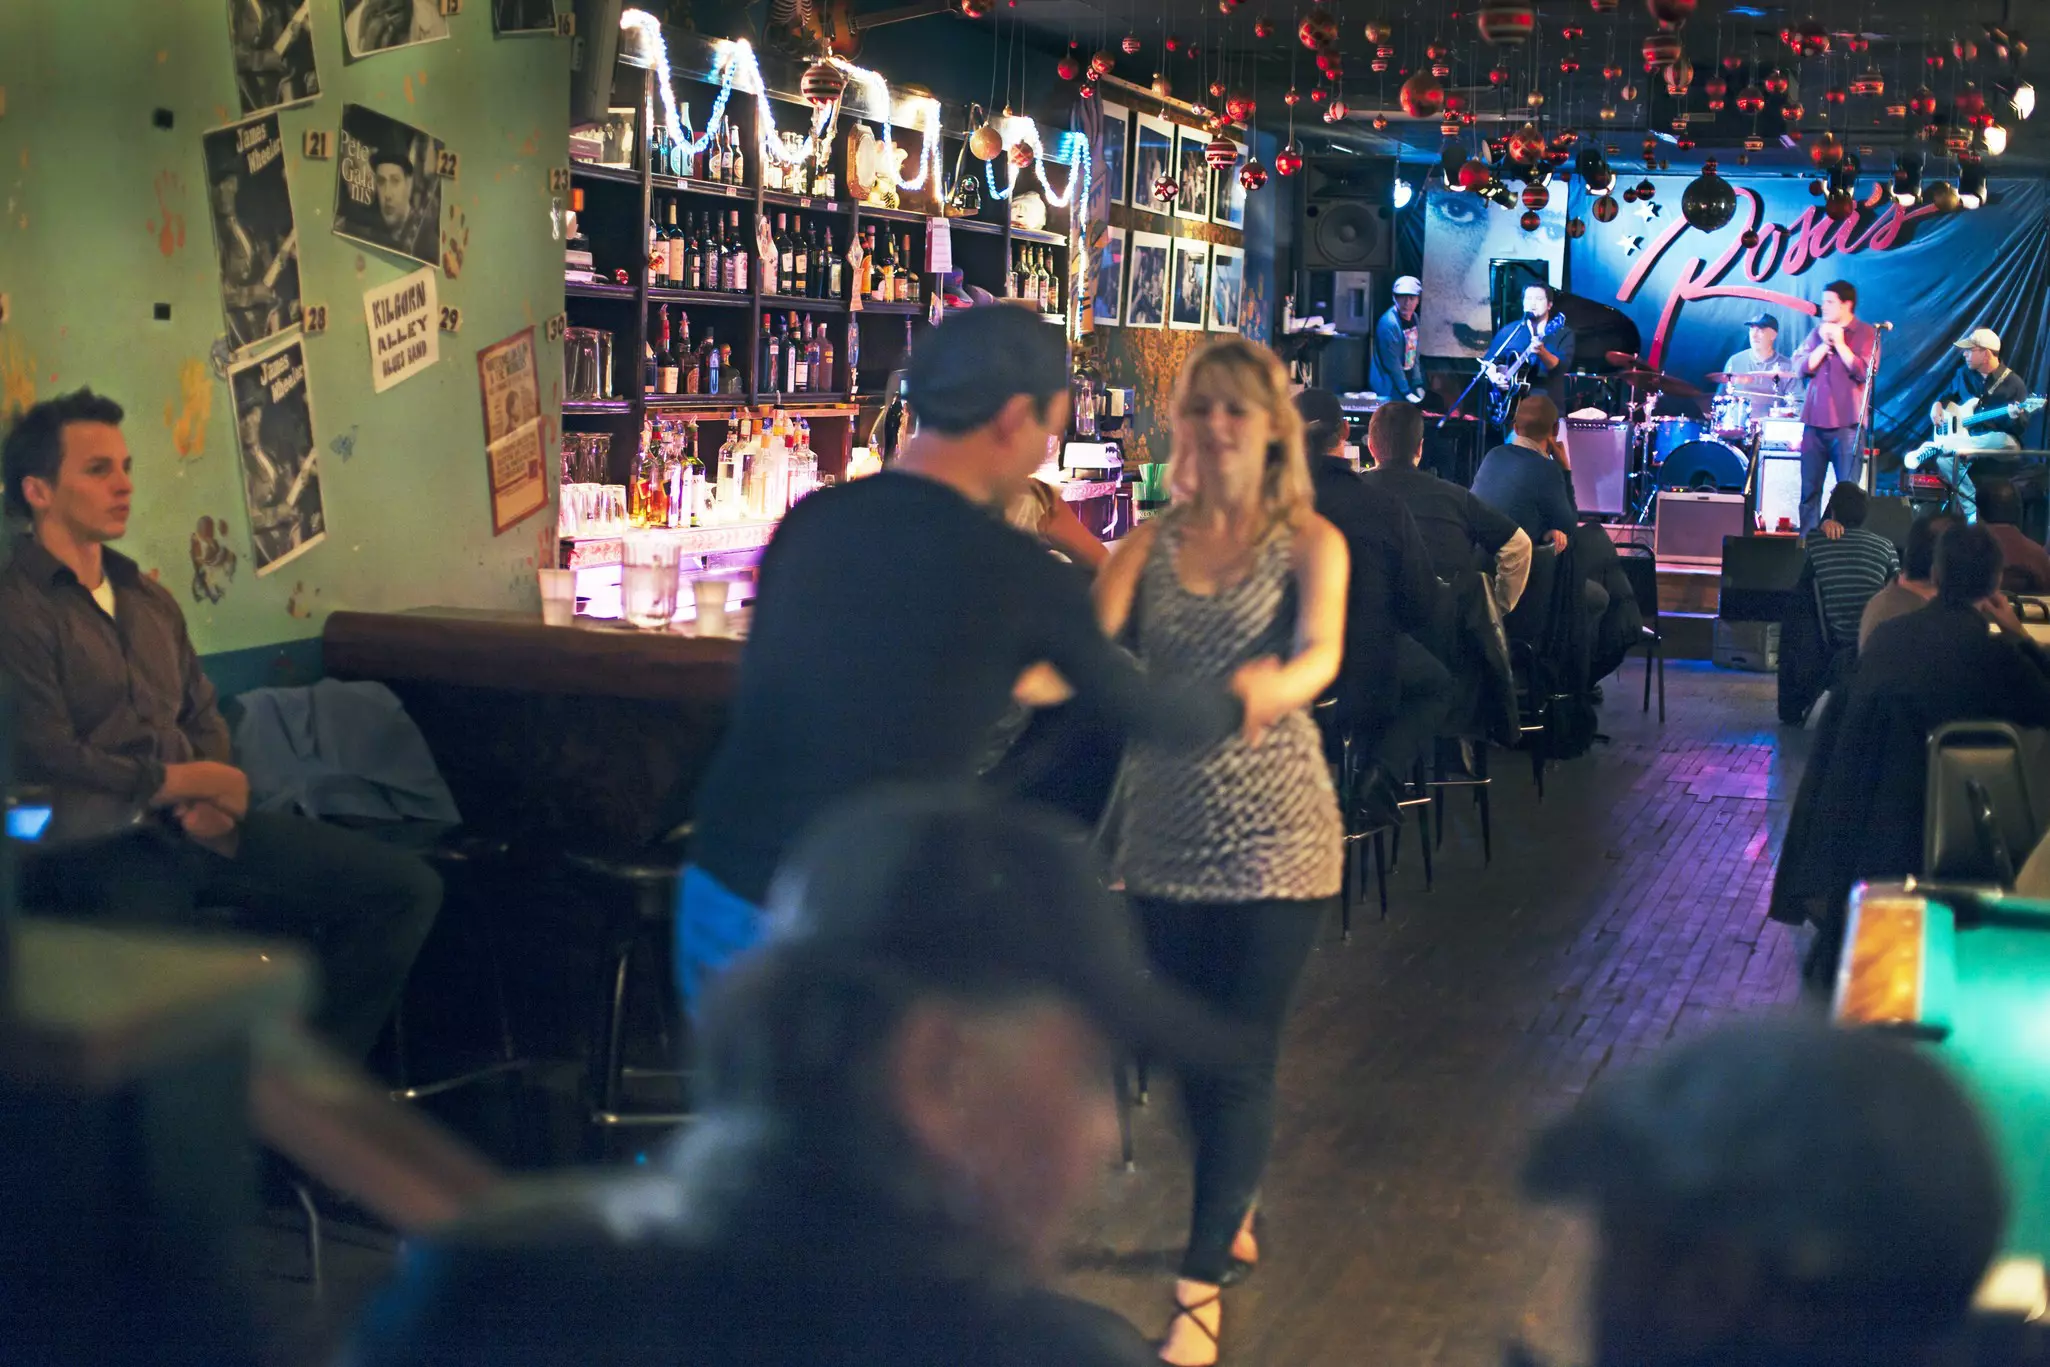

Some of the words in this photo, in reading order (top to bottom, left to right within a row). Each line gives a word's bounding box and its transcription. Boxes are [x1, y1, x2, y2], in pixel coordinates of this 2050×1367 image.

[557, 14, 570, 35] 16
[236, 123, 267, 153] James
[309, 132, 326, 155] 21
[341, 129, 369, 162] Pete
[341, 157, 375, 191] Gala
[439, 153, 456, 176] 22
[553, 169, 568, 190] 23
[351, 183, 373, 205] nis
[308, 306, 326, 331] 28
[439, 306, 459, 330] 29
[550, 315, 564, 341] 30
[377, 314, 428, 356] ALLEY
[407, 340, 427, 364] BAND
[261, 354, 289, 386] James
